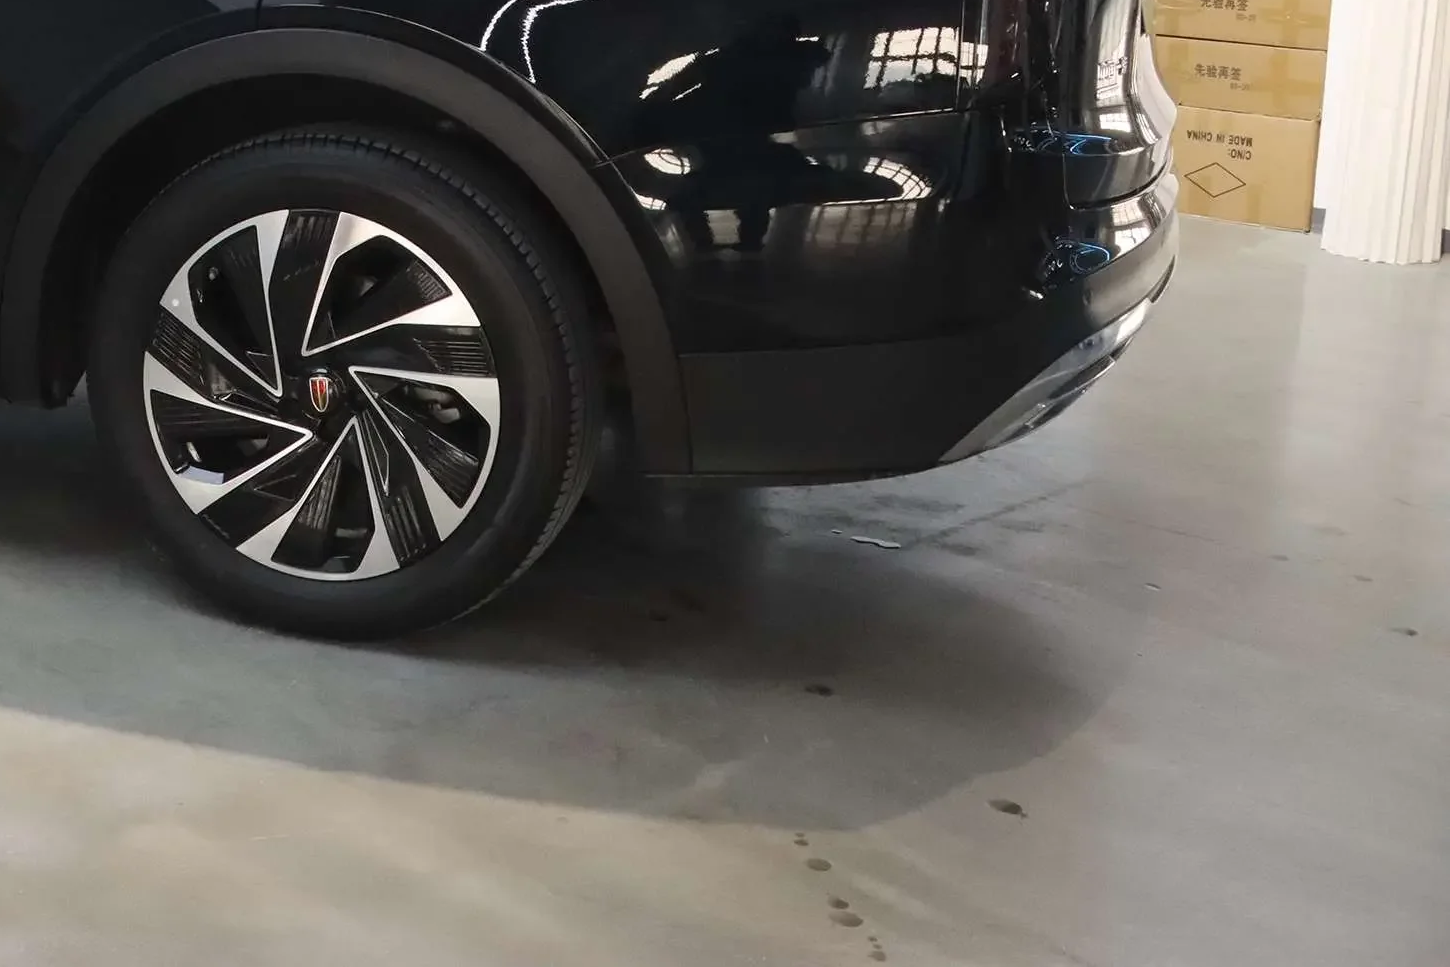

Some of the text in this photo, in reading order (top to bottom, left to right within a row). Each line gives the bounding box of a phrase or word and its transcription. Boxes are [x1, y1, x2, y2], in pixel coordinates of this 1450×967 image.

[1186, 129, 1253, 147] MADE IN CHINA
